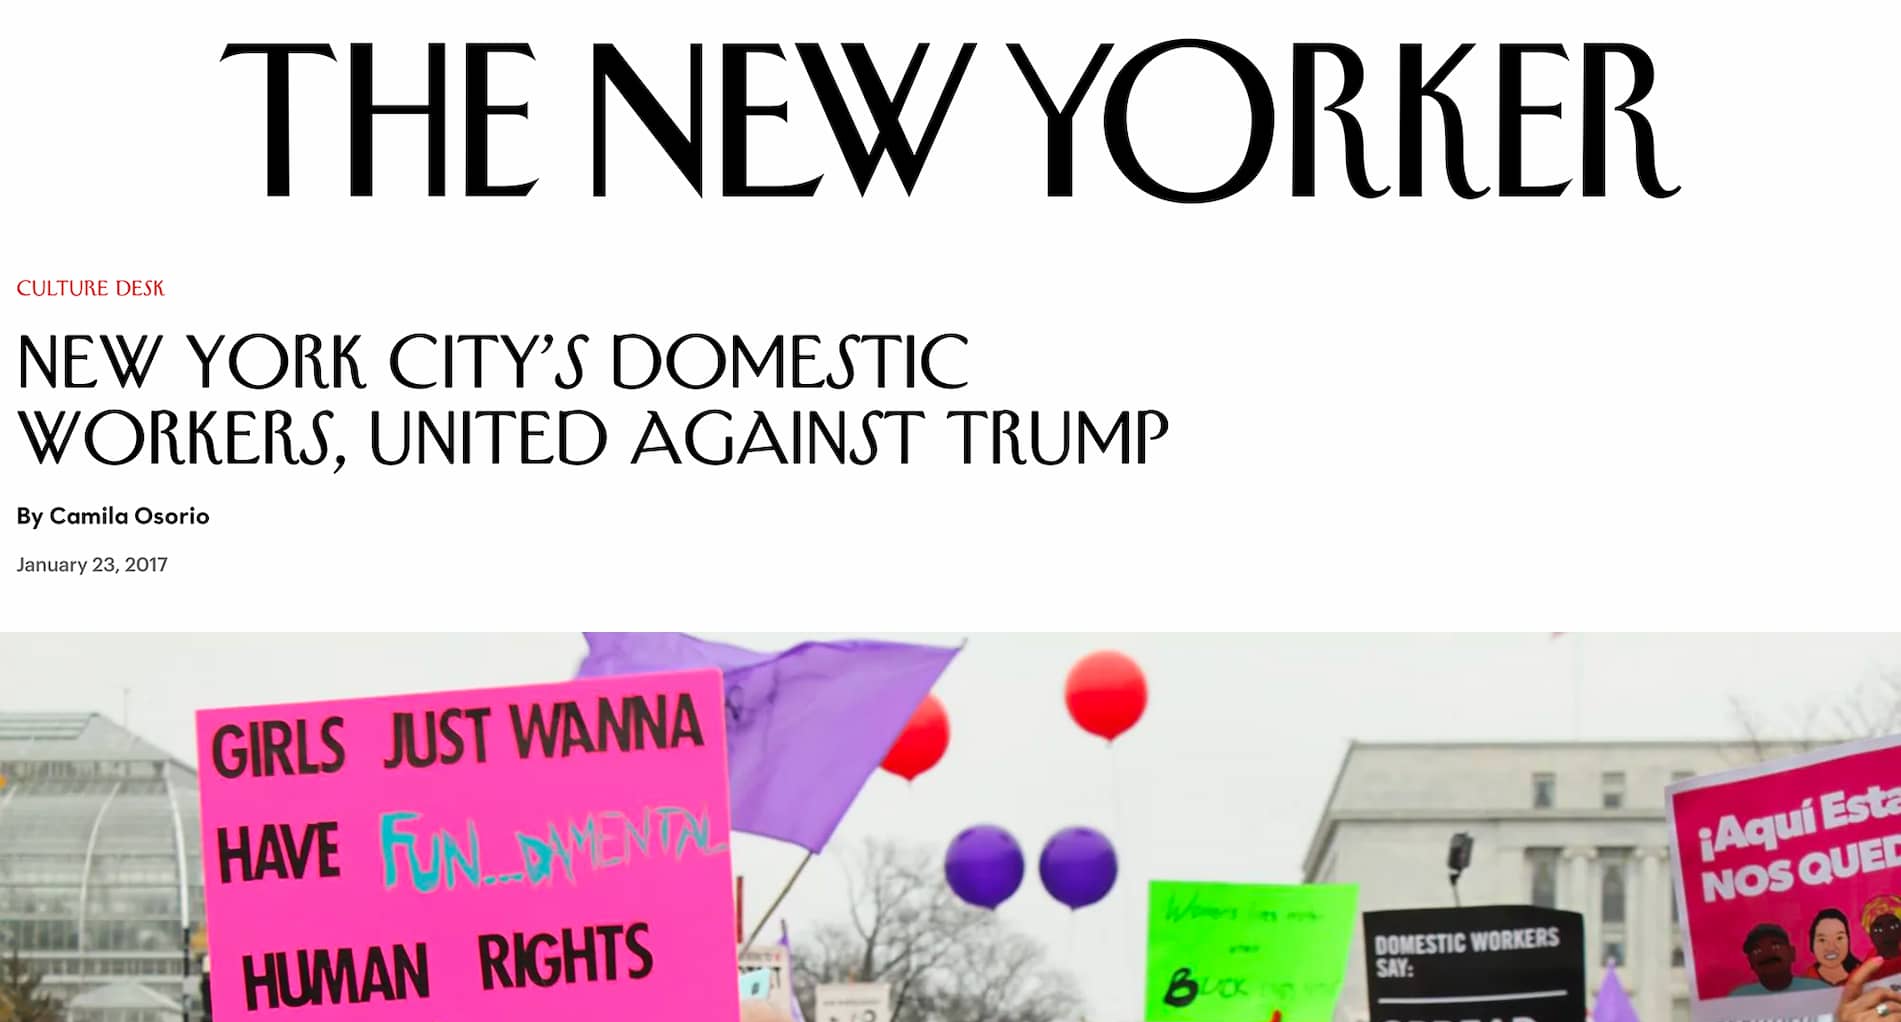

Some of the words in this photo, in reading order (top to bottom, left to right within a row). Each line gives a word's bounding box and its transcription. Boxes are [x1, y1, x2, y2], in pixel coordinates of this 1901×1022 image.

[212, 716, 345, 779] GIRLS
[384, 707, 491, 769] JUST
[510, 693, 704, 760] WANNA
[217, 821, 340, 884] HAVE
[1698, 798, 1817, 862] ¡Aquí
[1702, 859, 1795, 902] NOS
[242, 942, 430, 1010] HUMAN
[478, 922, 653, 990] RIGHTS
[1374, 932, 1467, 955] DOMESTIC
[1470, 927, 1560, 952] WORKERS
[1376, 957, 1414, 978] SAY:
